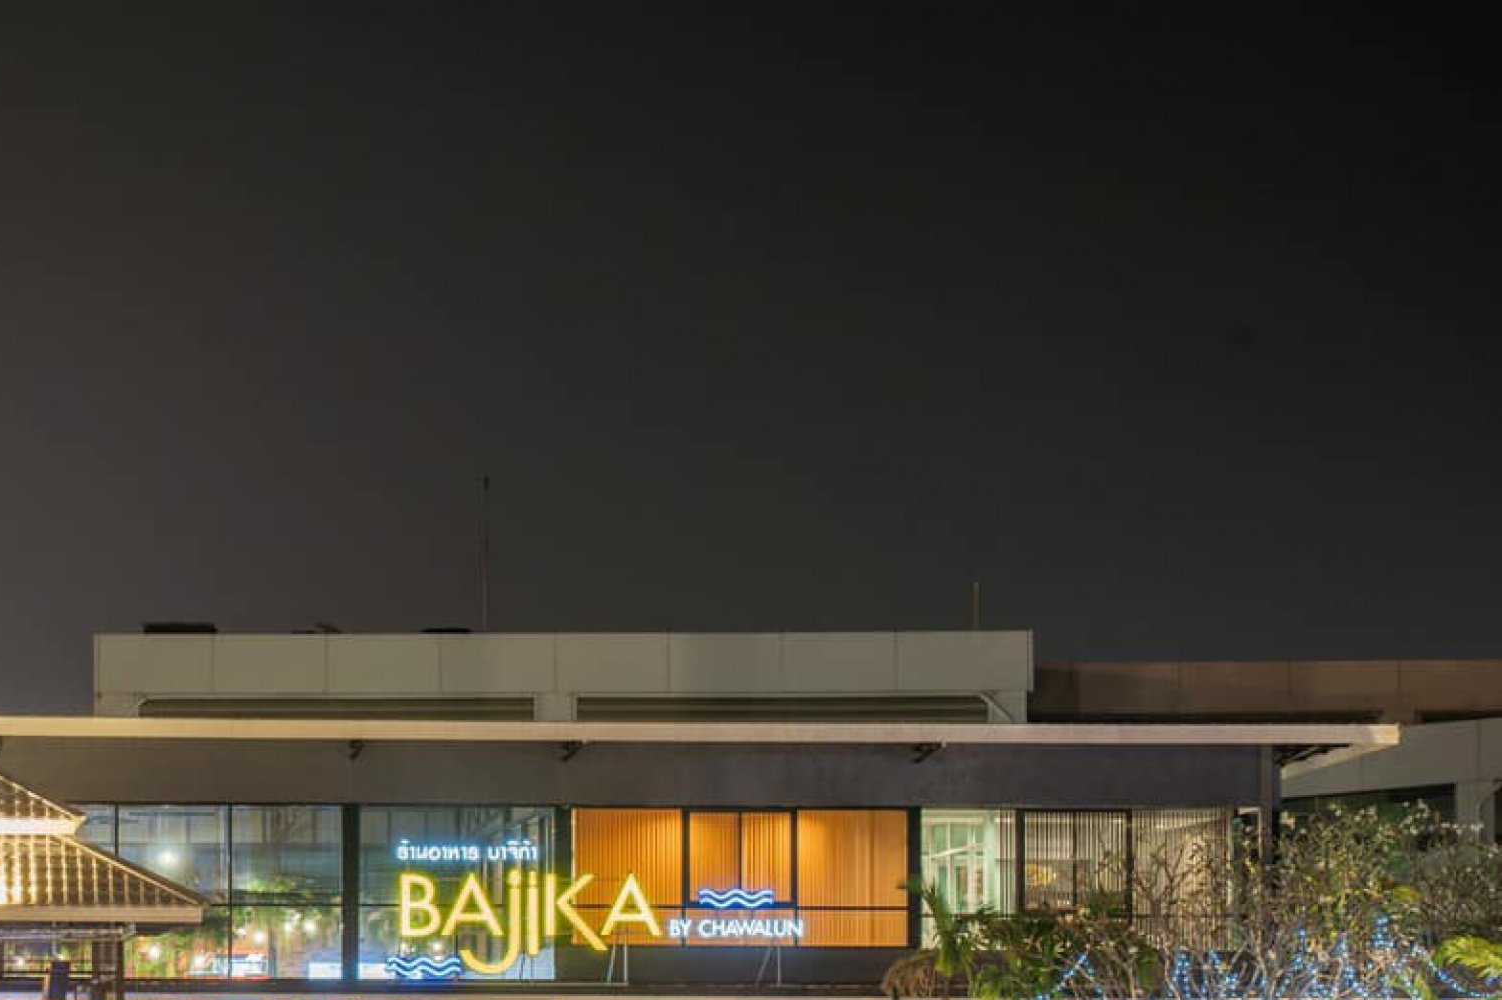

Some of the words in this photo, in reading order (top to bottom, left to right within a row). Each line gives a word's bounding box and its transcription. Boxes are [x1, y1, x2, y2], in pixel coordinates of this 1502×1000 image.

[396, 838, 479, 861] ร้านอาหาร
[669, 919, 691, 937] BY
[698, 918, 804, 938] CHAWALUN
